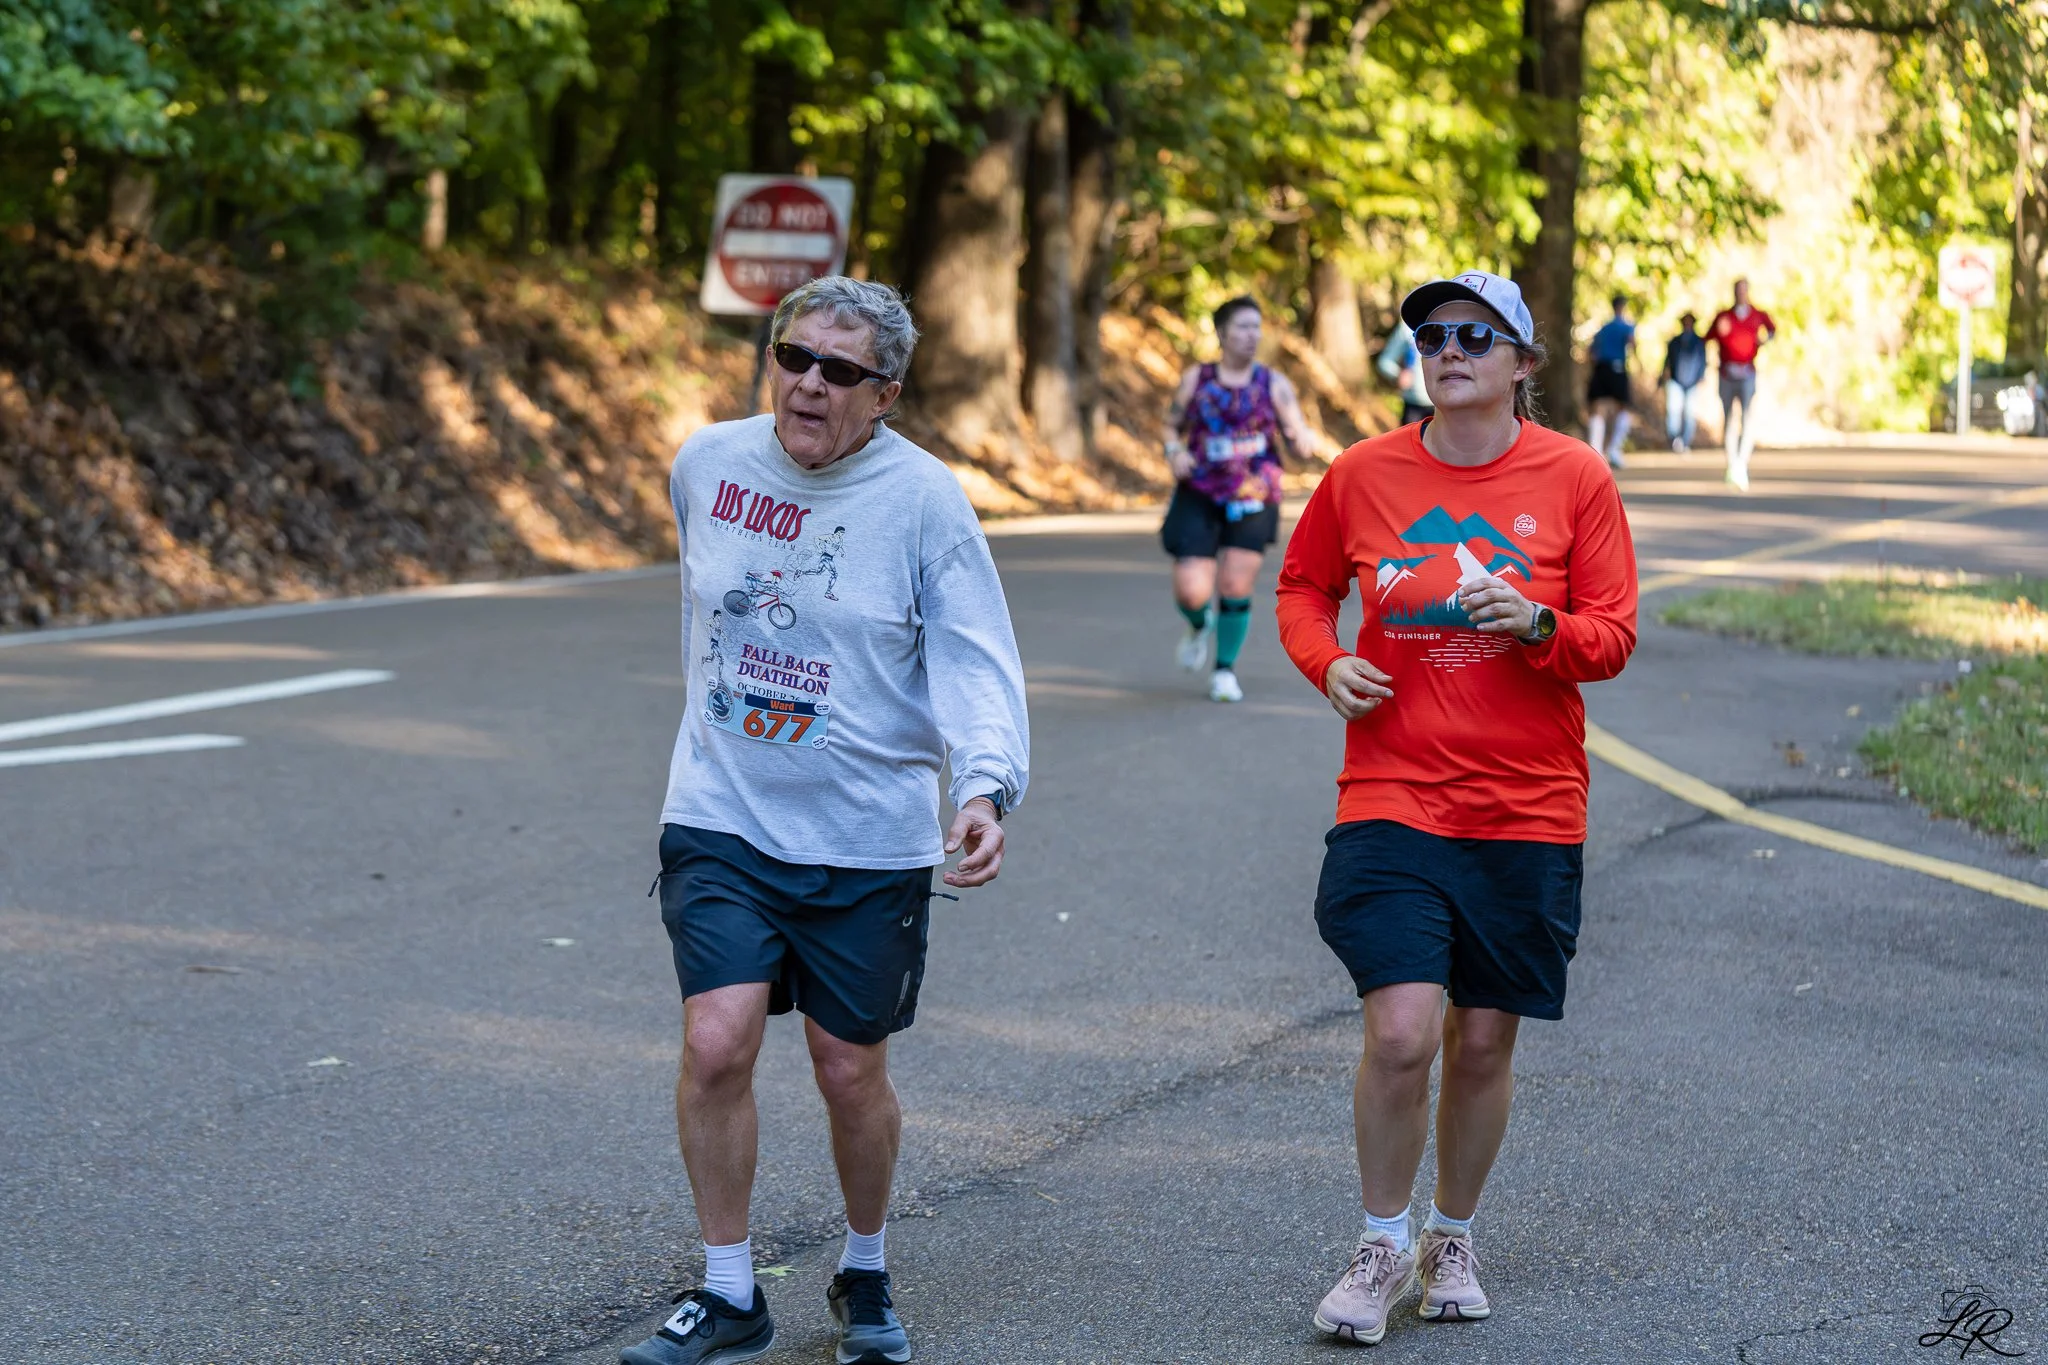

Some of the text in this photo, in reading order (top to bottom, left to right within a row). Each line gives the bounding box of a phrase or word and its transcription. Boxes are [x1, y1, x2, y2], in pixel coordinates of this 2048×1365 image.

[777, 202, 828, 229] NOT
[710, 480, 811, 542] LOS LOCOS
[710, 519, 796, 551] TRIATHLON TEAM
[1384, 630, 1441, 640] CDA FINISHER
[741, 643, 832, 679] FALL BACK
[737, 660, 830, 697] DUATHLON
[737, 681, 787, 700] OCTOBER
[770, 699, 795, 712] Ward
[743, 708, 815, 743] 677
